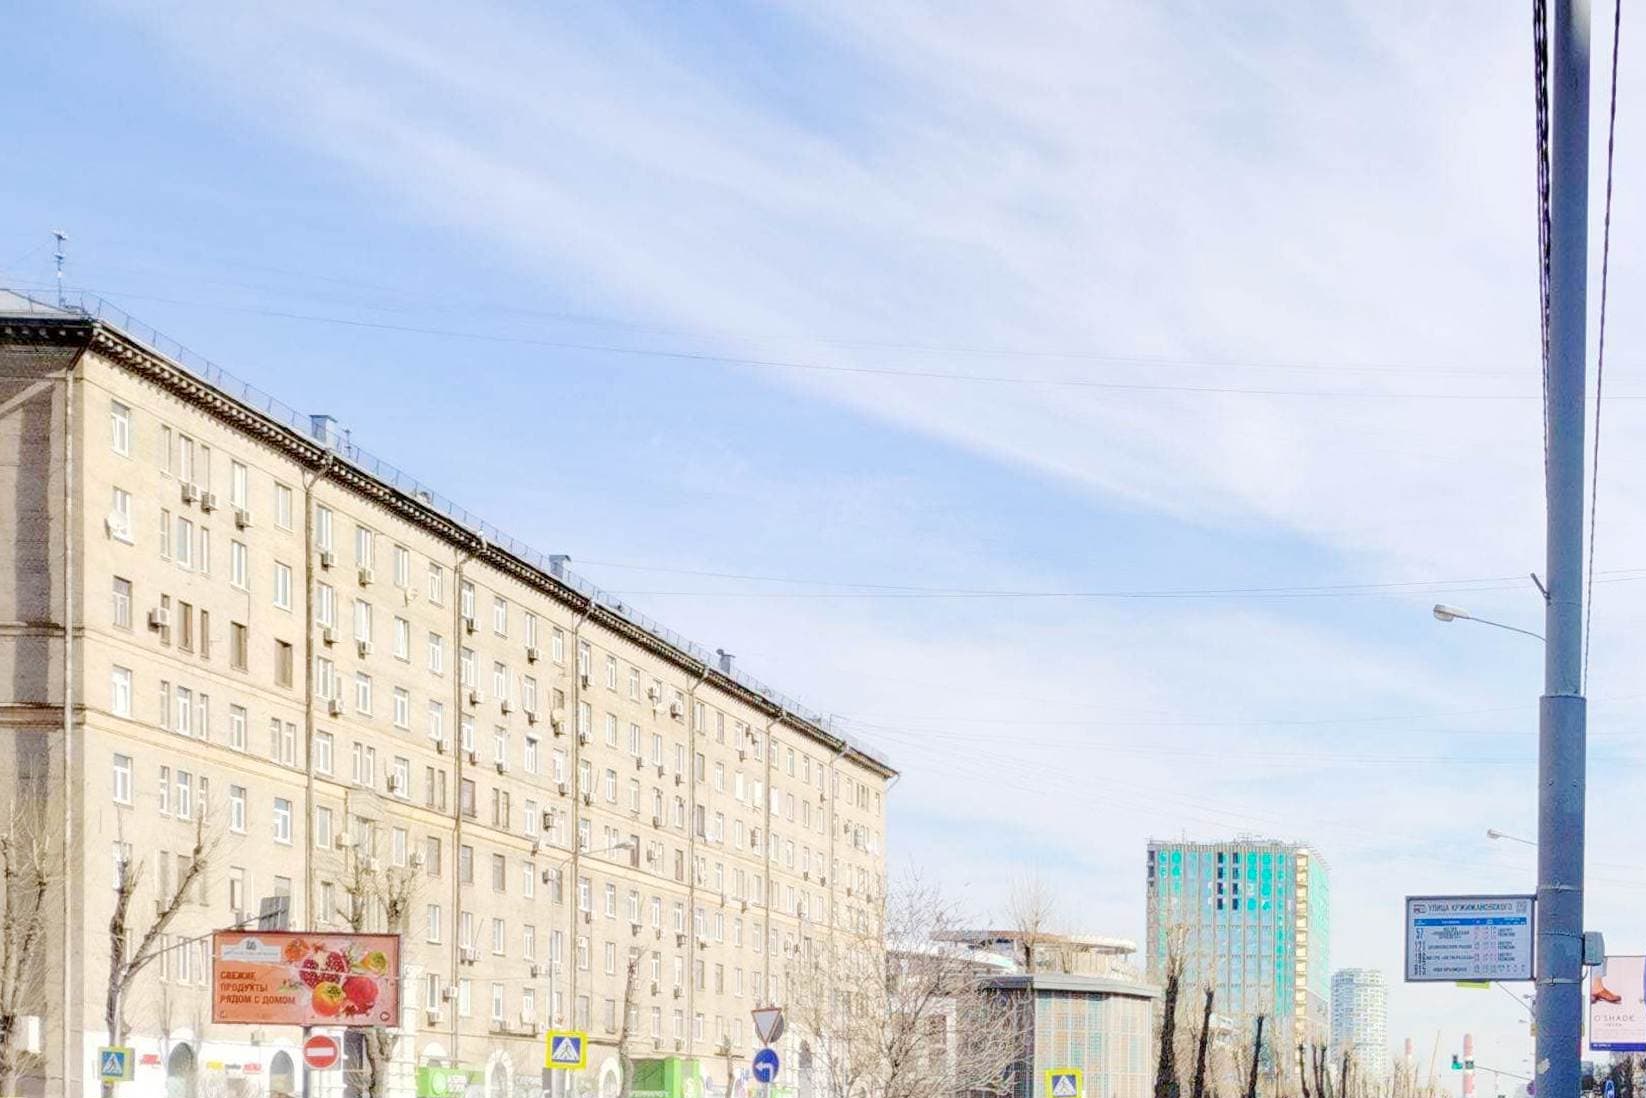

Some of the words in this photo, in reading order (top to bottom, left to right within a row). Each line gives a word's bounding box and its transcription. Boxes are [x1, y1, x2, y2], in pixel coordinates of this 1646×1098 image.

[220, 983, 268, 993] ПРОДУКТЫ
[220, 995, 252, 1004] РЯДОМ
[262, 996, 296, 1005] ДОМОМ
